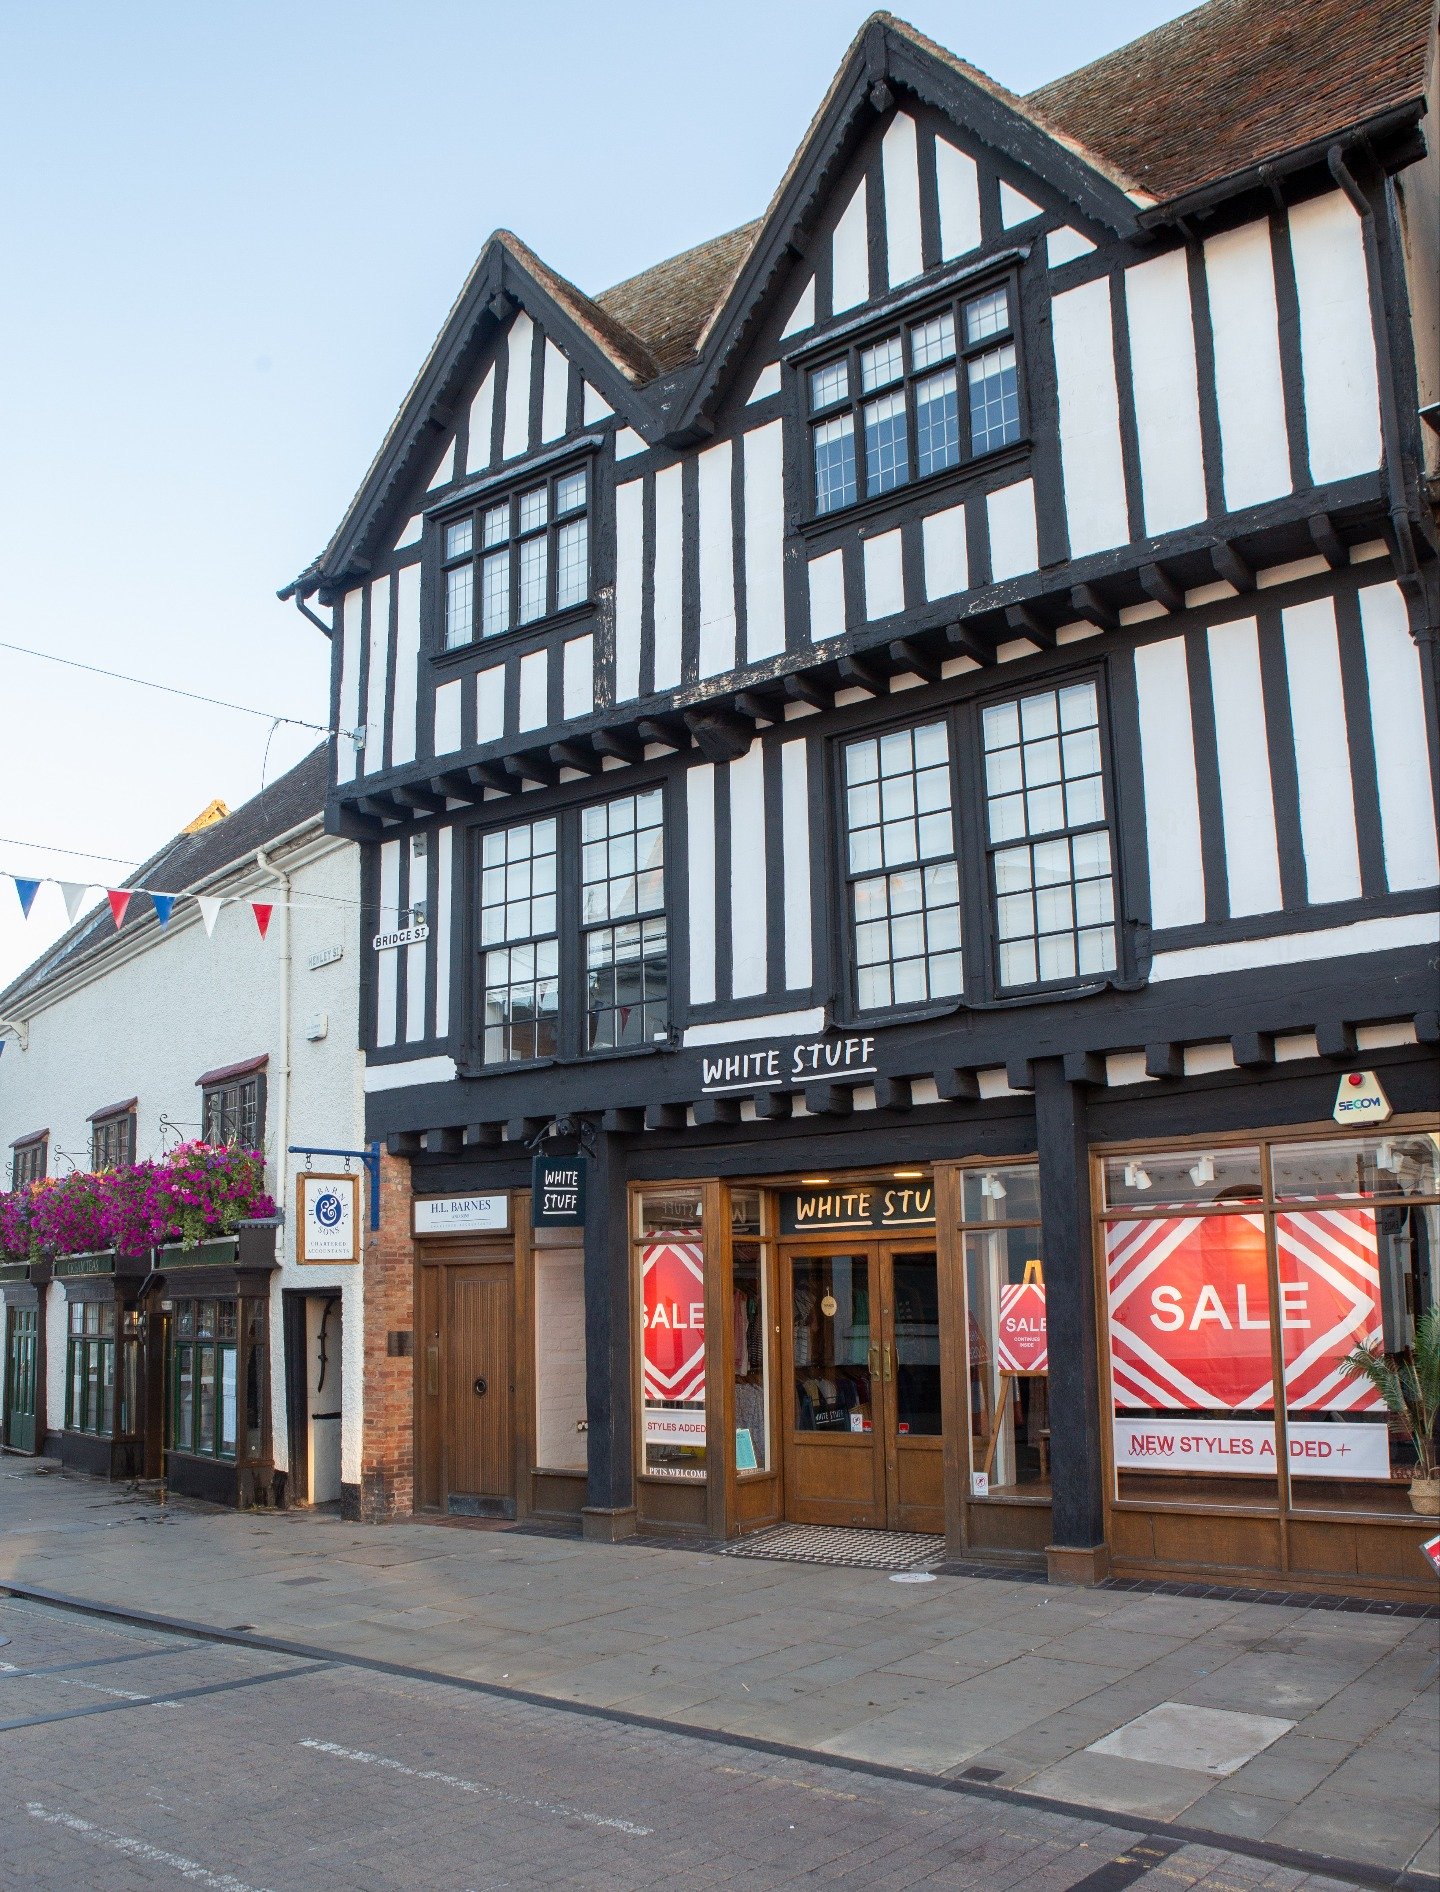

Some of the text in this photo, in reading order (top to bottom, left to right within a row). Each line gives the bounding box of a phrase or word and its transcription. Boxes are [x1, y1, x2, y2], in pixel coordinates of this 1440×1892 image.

[375, 927, 425, 947] BRIDGE ST
[308, 949, 332, 967] HENLEY
[702, 1037, 875, 1084] WHITE STUFF
[1338, 1096, 1381, 1111] SECOM
[545, 1170, 578, 1186] WHITE
[431, 1200, 491, 1213] H.L. BARNES
[543, 1194, 577, 1210] STUFF
[796, 1188, 932, 1221] WHITE STU
[318, 1226, 340, 1236] SONS
[1149, 1281, 1311, 1331] SALE
[1006, 1317, 1046, 1332] SALE
[647, 1421, 706, 1433] STYLES ADDED
[1131, 1434, 1174, 1451] NEW
[1179, 1437, 1254, 1455] STYLES
[1259, 1439, 1332, 1458] ADED
[649, 1467, 707, 1479] PETS WELCOME
